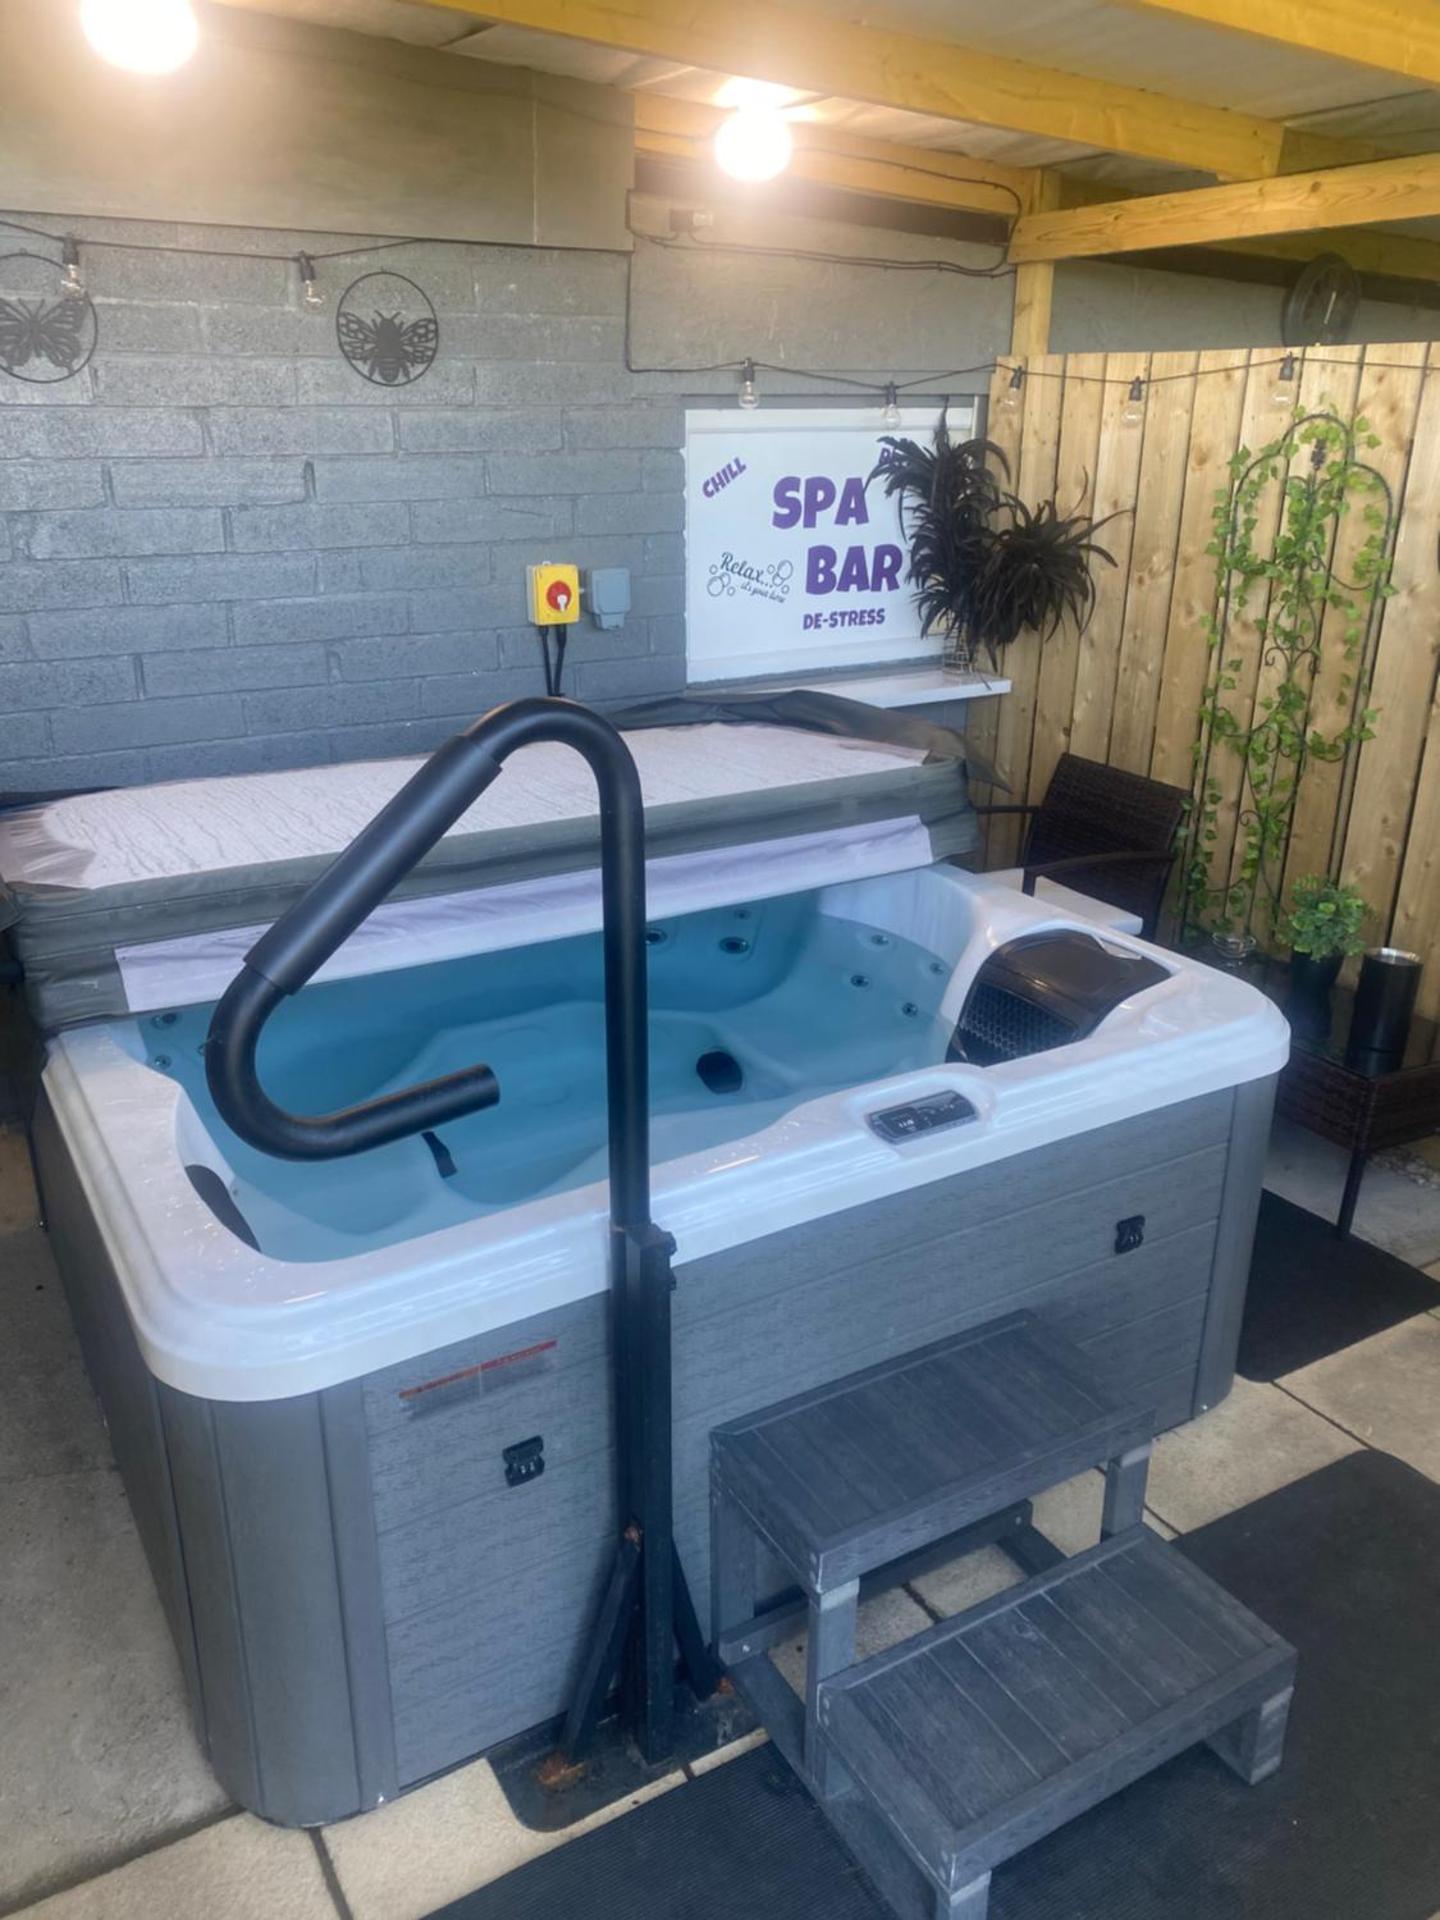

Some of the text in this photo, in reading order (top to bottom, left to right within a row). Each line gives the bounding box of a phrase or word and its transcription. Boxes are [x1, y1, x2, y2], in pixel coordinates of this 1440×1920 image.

[702, 457, 747, 498] CHILL
[772, 476, 869, 530] SPA
[805, 544, 903, 595] BAR
[803, 608, 886, 630] DE-STRESS
